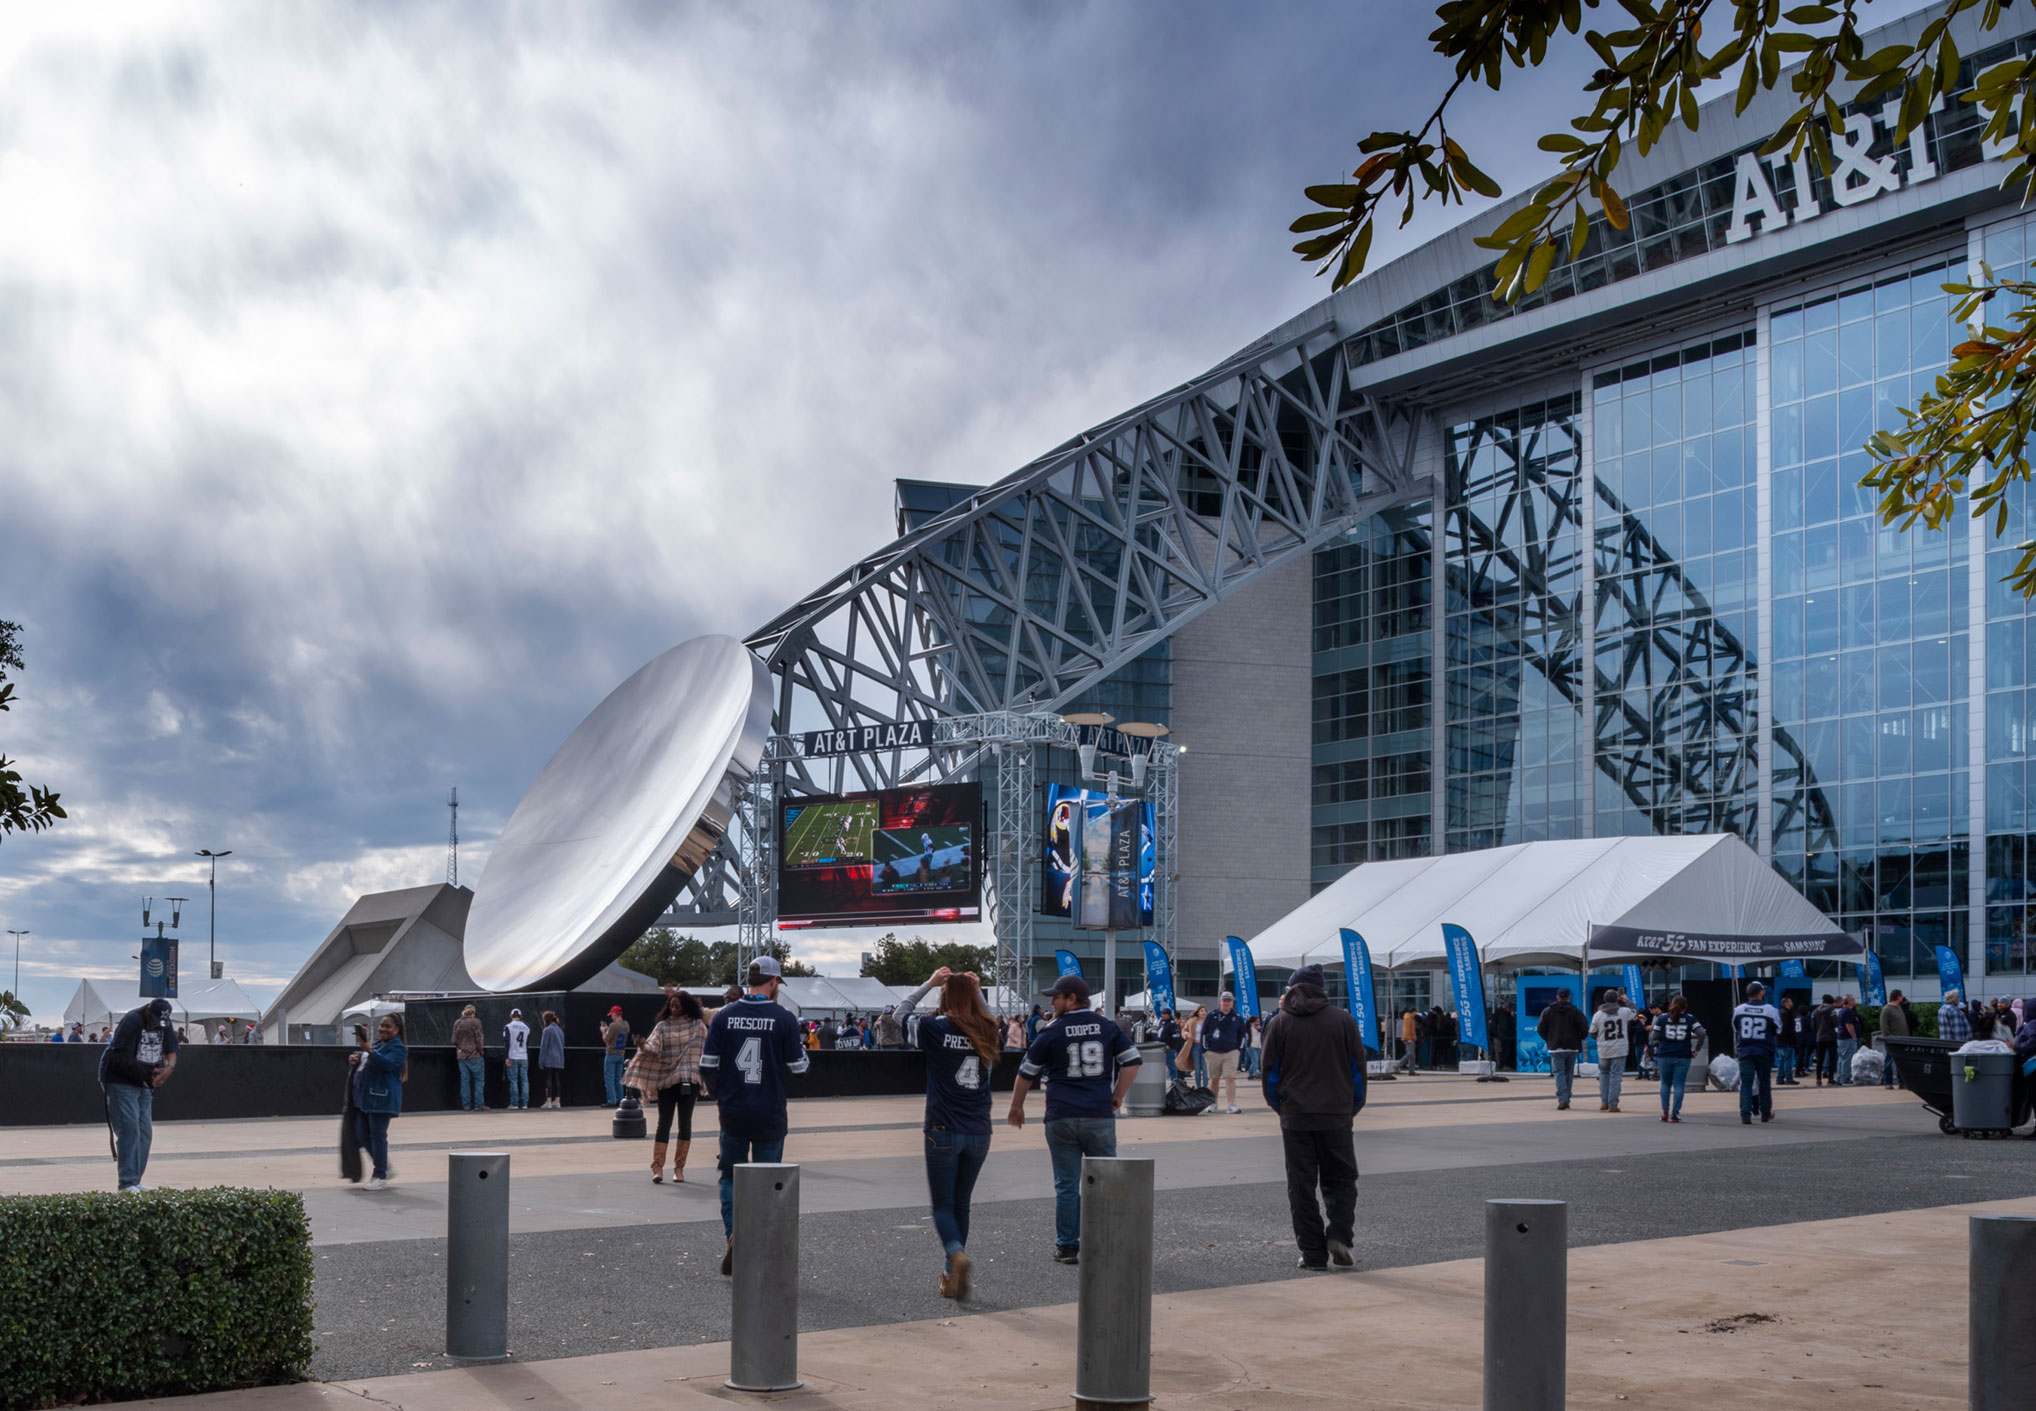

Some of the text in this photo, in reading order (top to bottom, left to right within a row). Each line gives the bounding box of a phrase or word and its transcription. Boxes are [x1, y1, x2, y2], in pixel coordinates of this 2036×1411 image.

[1725, 91, 1944, 244] AT&T
[813, 723, 922, 753] AT&T PLAZA
[1087, 725, 1148, 755] AT&T PLAZA
[1118, 830, 1130, 897] AT&T PLAZA
[1461, 936, 1472, 971] SAMSUNG
[1636, 935, 1664, 948] AT&T
[1662, 934, 1686, 952] 5G
[1687, 939, 1707, 952] FAN
[1708, 941, 1761, 953] EXPERIENCE
[1784, 940, 1826, 953] SAMSUNG
[1349, 942, 1359, 985] EXPERIENCE
[1453, 938, 1465, 981] EXPERIENCE
[1460, 983, 1468, 998] FAN
[1356, 1003, 1365, 1018] 5G
[1460, 1000, 1471, 1017] 5G
[727, 1017, 775, 1031] PRESCOTT
[1065, 1023, 1101, 1037] COOPER
[1464, 1018, 1472, 1037] AT&T
[1604, 1019, 1624, 1041] 21
[1665, 1024, 1688, 1040] 55
[1741, 1017, 1767, 1039] 82
[516, 1031, 524, 1047] 4
[735, 1037, 762, 1084] 4
[1066, 1041, 1104, 1077] 19
[954, 1055, 980, 1089] 4
